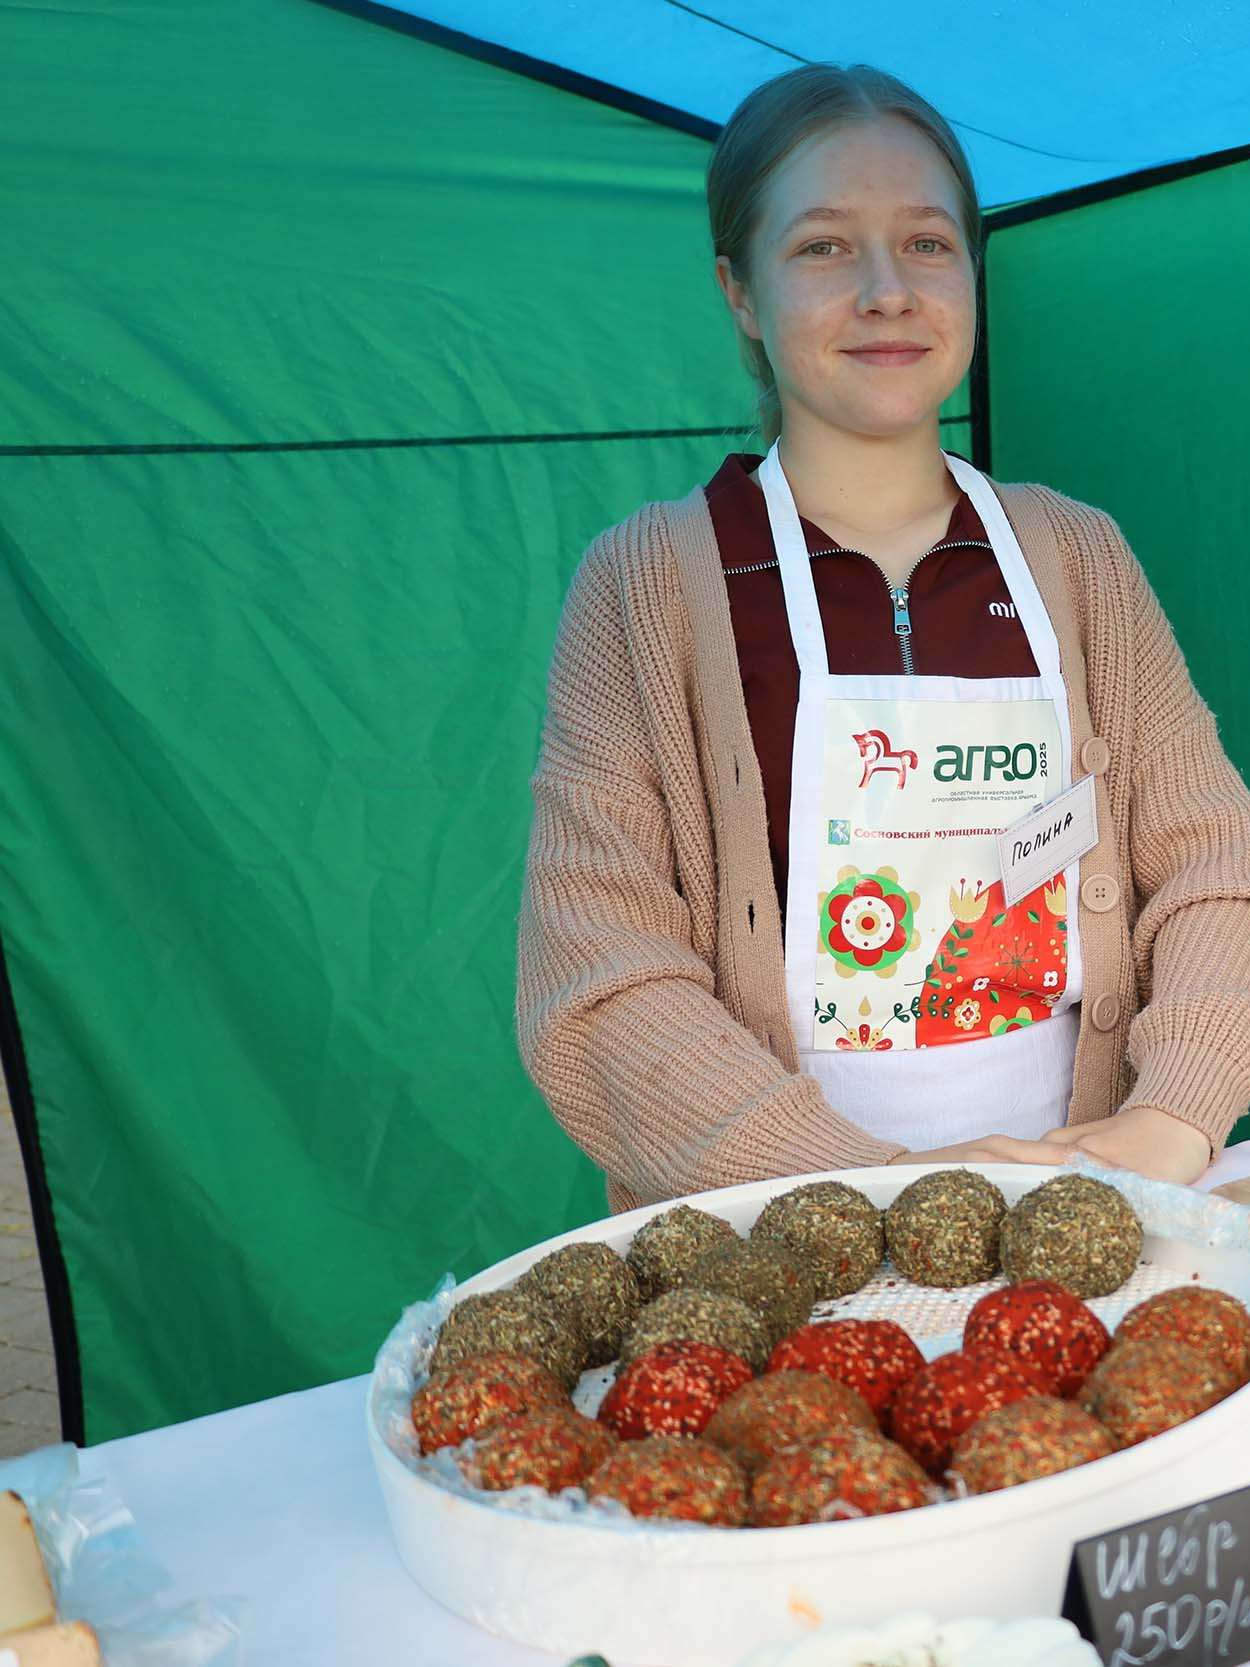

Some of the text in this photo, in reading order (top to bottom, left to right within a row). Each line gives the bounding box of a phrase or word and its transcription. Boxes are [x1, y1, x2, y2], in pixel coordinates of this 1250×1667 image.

[1040, 742, 1048, 777] 2025
[854, 827, 1009, 841] Сосновский муниципаль
